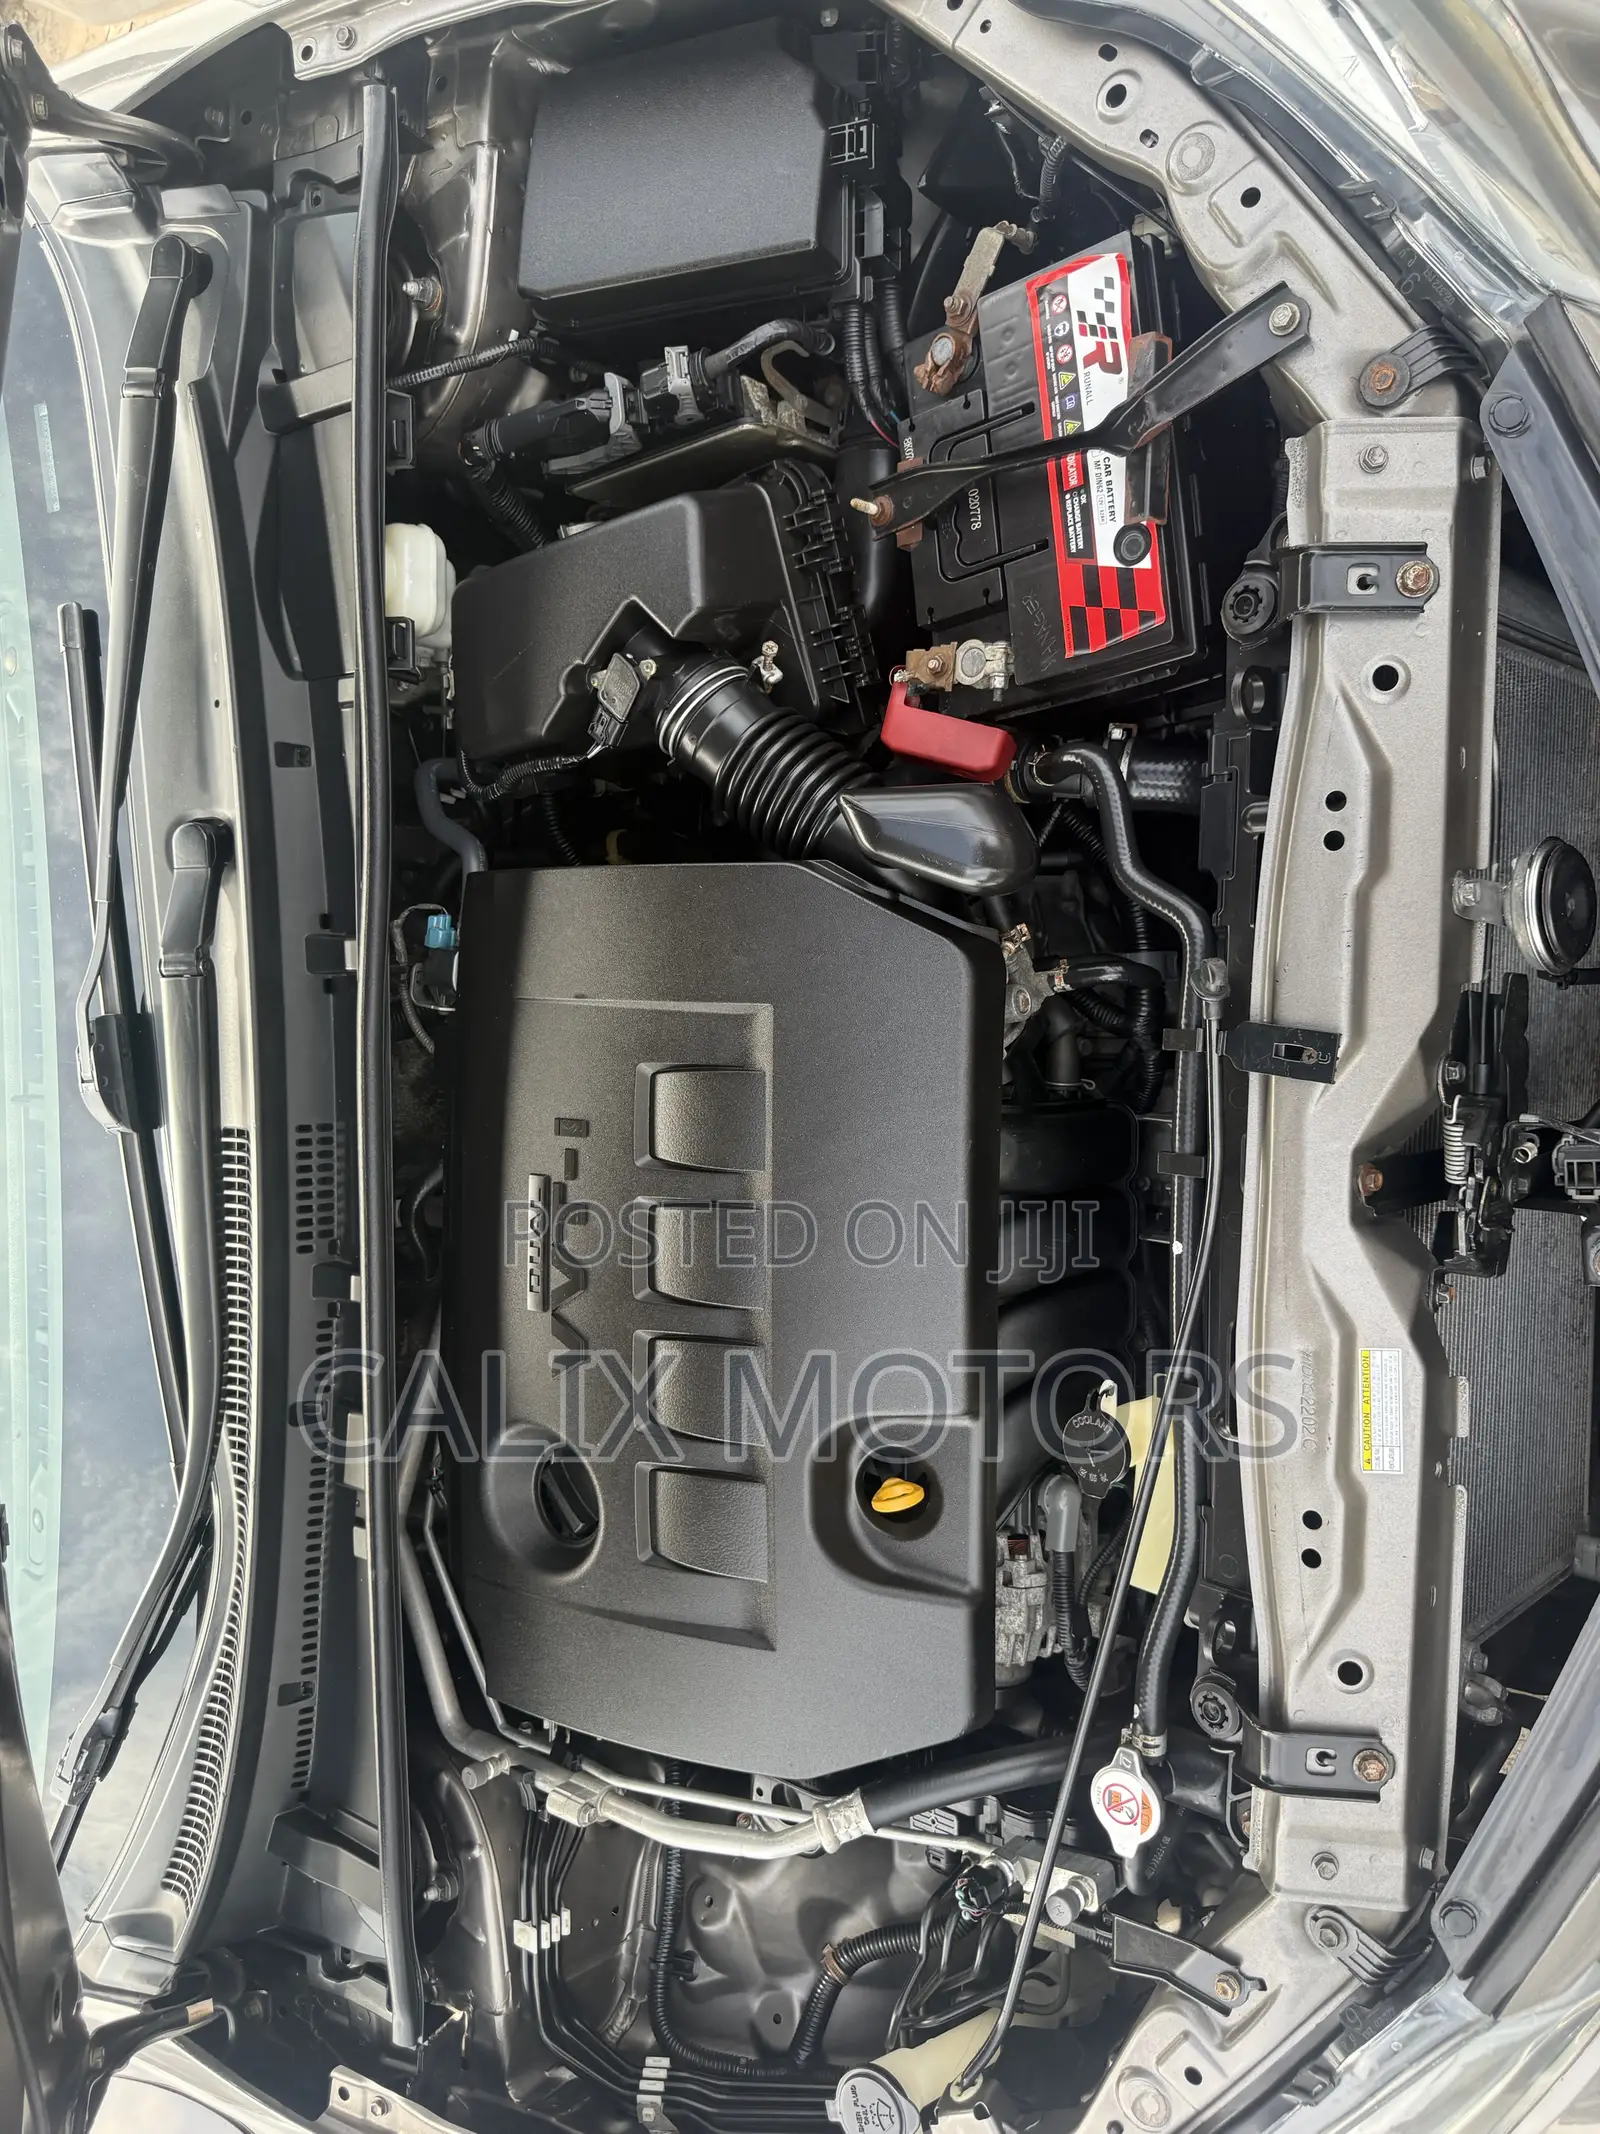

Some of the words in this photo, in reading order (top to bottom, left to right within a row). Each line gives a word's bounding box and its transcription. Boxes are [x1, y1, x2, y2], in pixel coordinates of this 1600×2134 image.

[1083, 371, 1094, 406] RUNALL
[903, 436, 914, 461] 8K07
[1094, 460, 1102, 470] MF
[1103, 456, 1112, 478] CAR
[968, 488, 982, 531] 020778
[1065, 499, 1074, 526] REPLACE
[1073, 496, 1081, 523] CHARGE
[1080, 494, 1087, 505] OK
[1106, 479, 1116, 523] BATTERY
[1068, 526, 1077, 553] BATTERY
[1076, 523, 1084, 550] BATTERY
[528, 1187, 542, 1294] DUAL
[1362, 1355, 1370, 1405] ATTENTION
[1072, 1415, 1114, 1434] COOLANT
[1363, 1411, 1371, 1452] CAUTION
[850, 2084, 860, 2108] FLUID
[855, 2111, 865, 2134] SHER
[860, 2104, 870, 2126] ONLY
